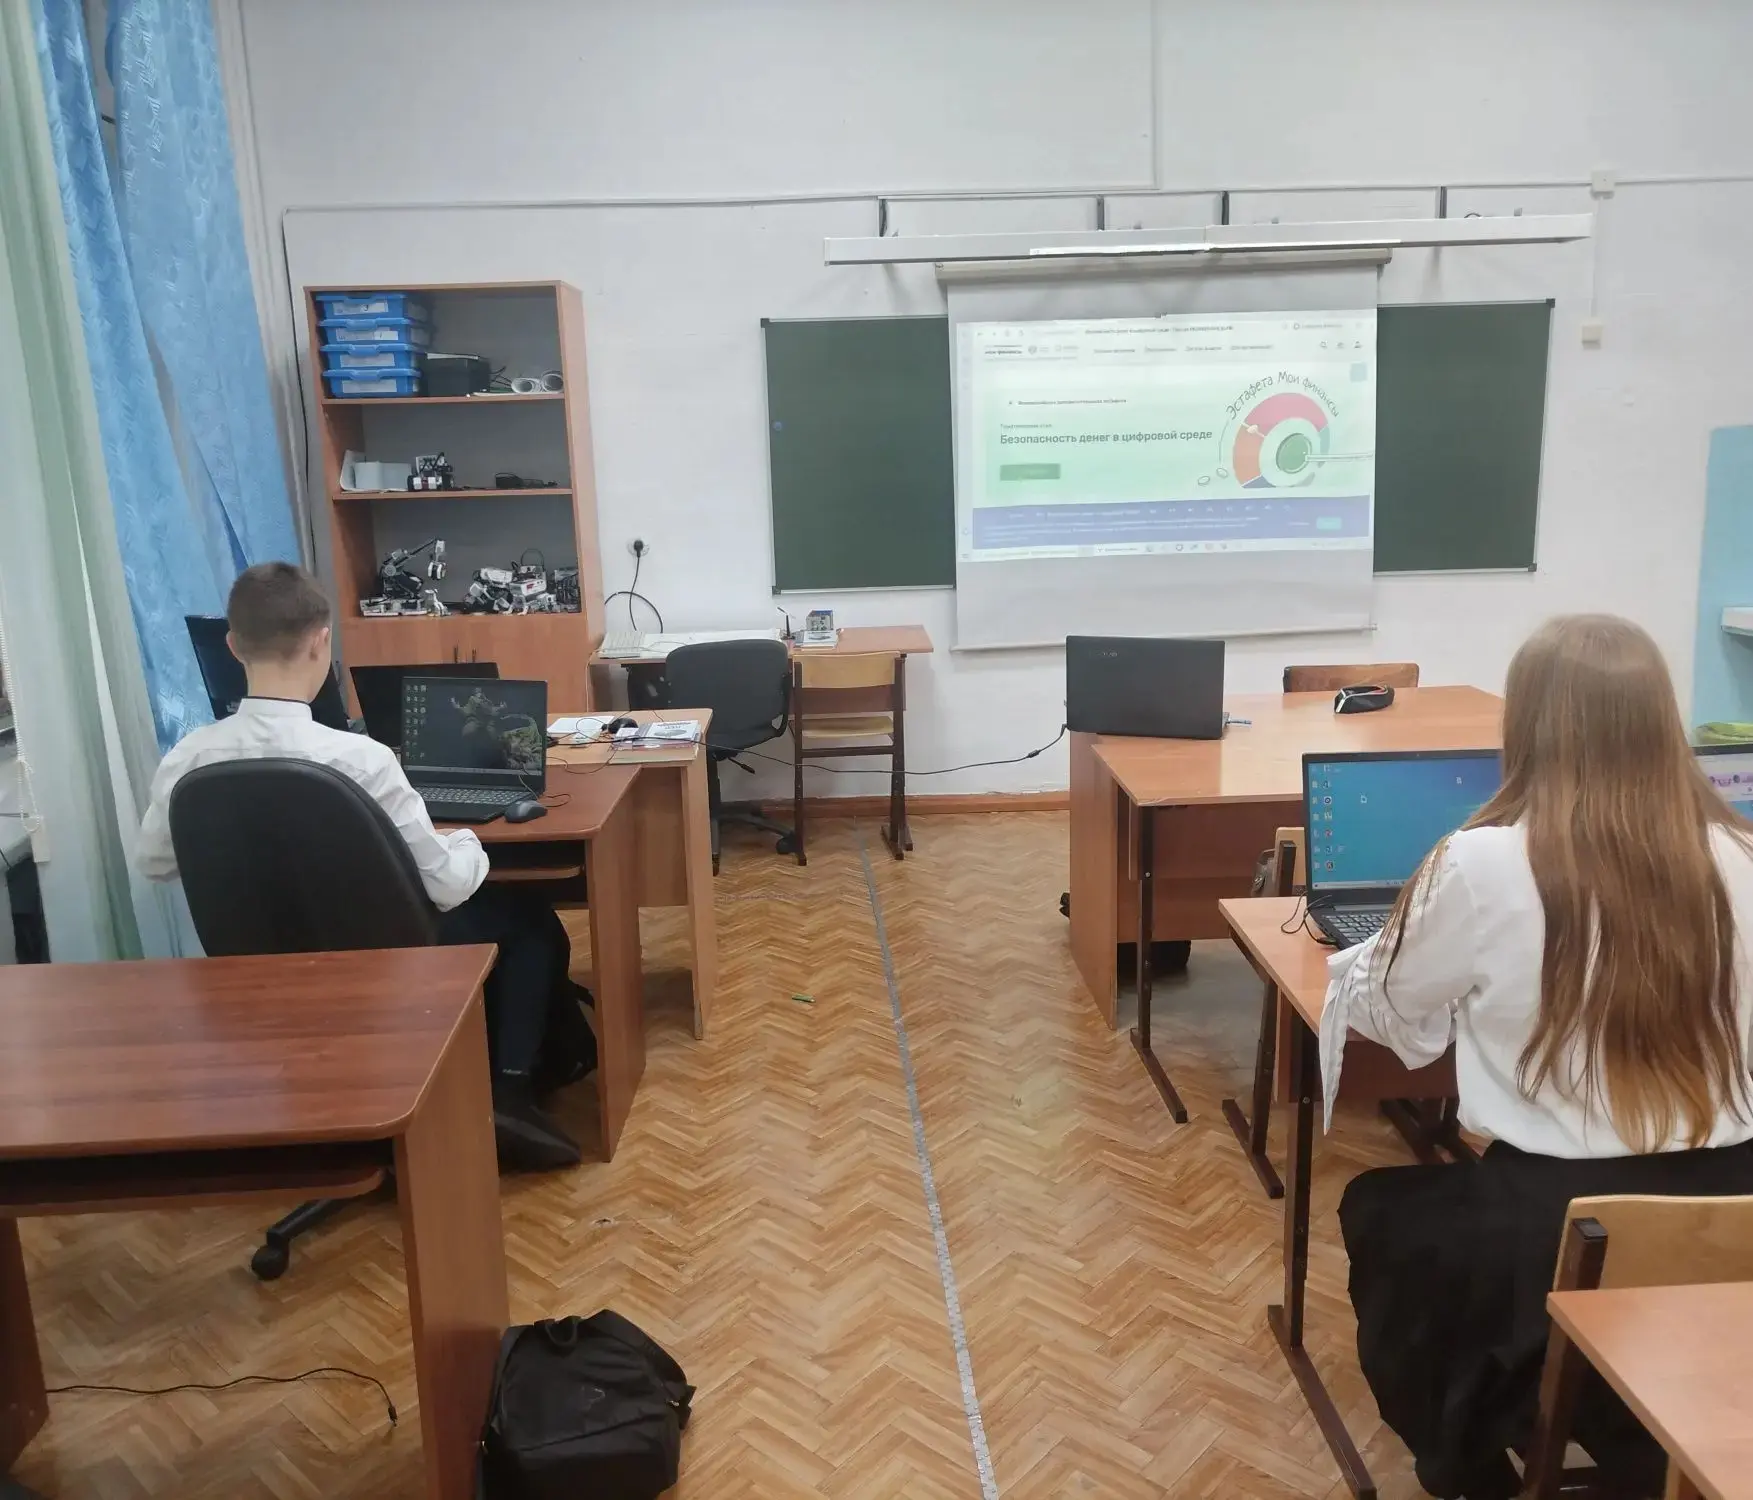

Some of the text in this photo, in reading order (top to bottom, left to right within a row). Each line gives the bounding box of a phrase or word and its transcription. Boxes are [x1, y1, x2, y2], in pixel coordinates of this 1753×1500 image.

[1226, 371, 1339, 420] Эстафета Мои финансы
[1000, 430, 1213, 445] Безопасность денег в цифровой среде
